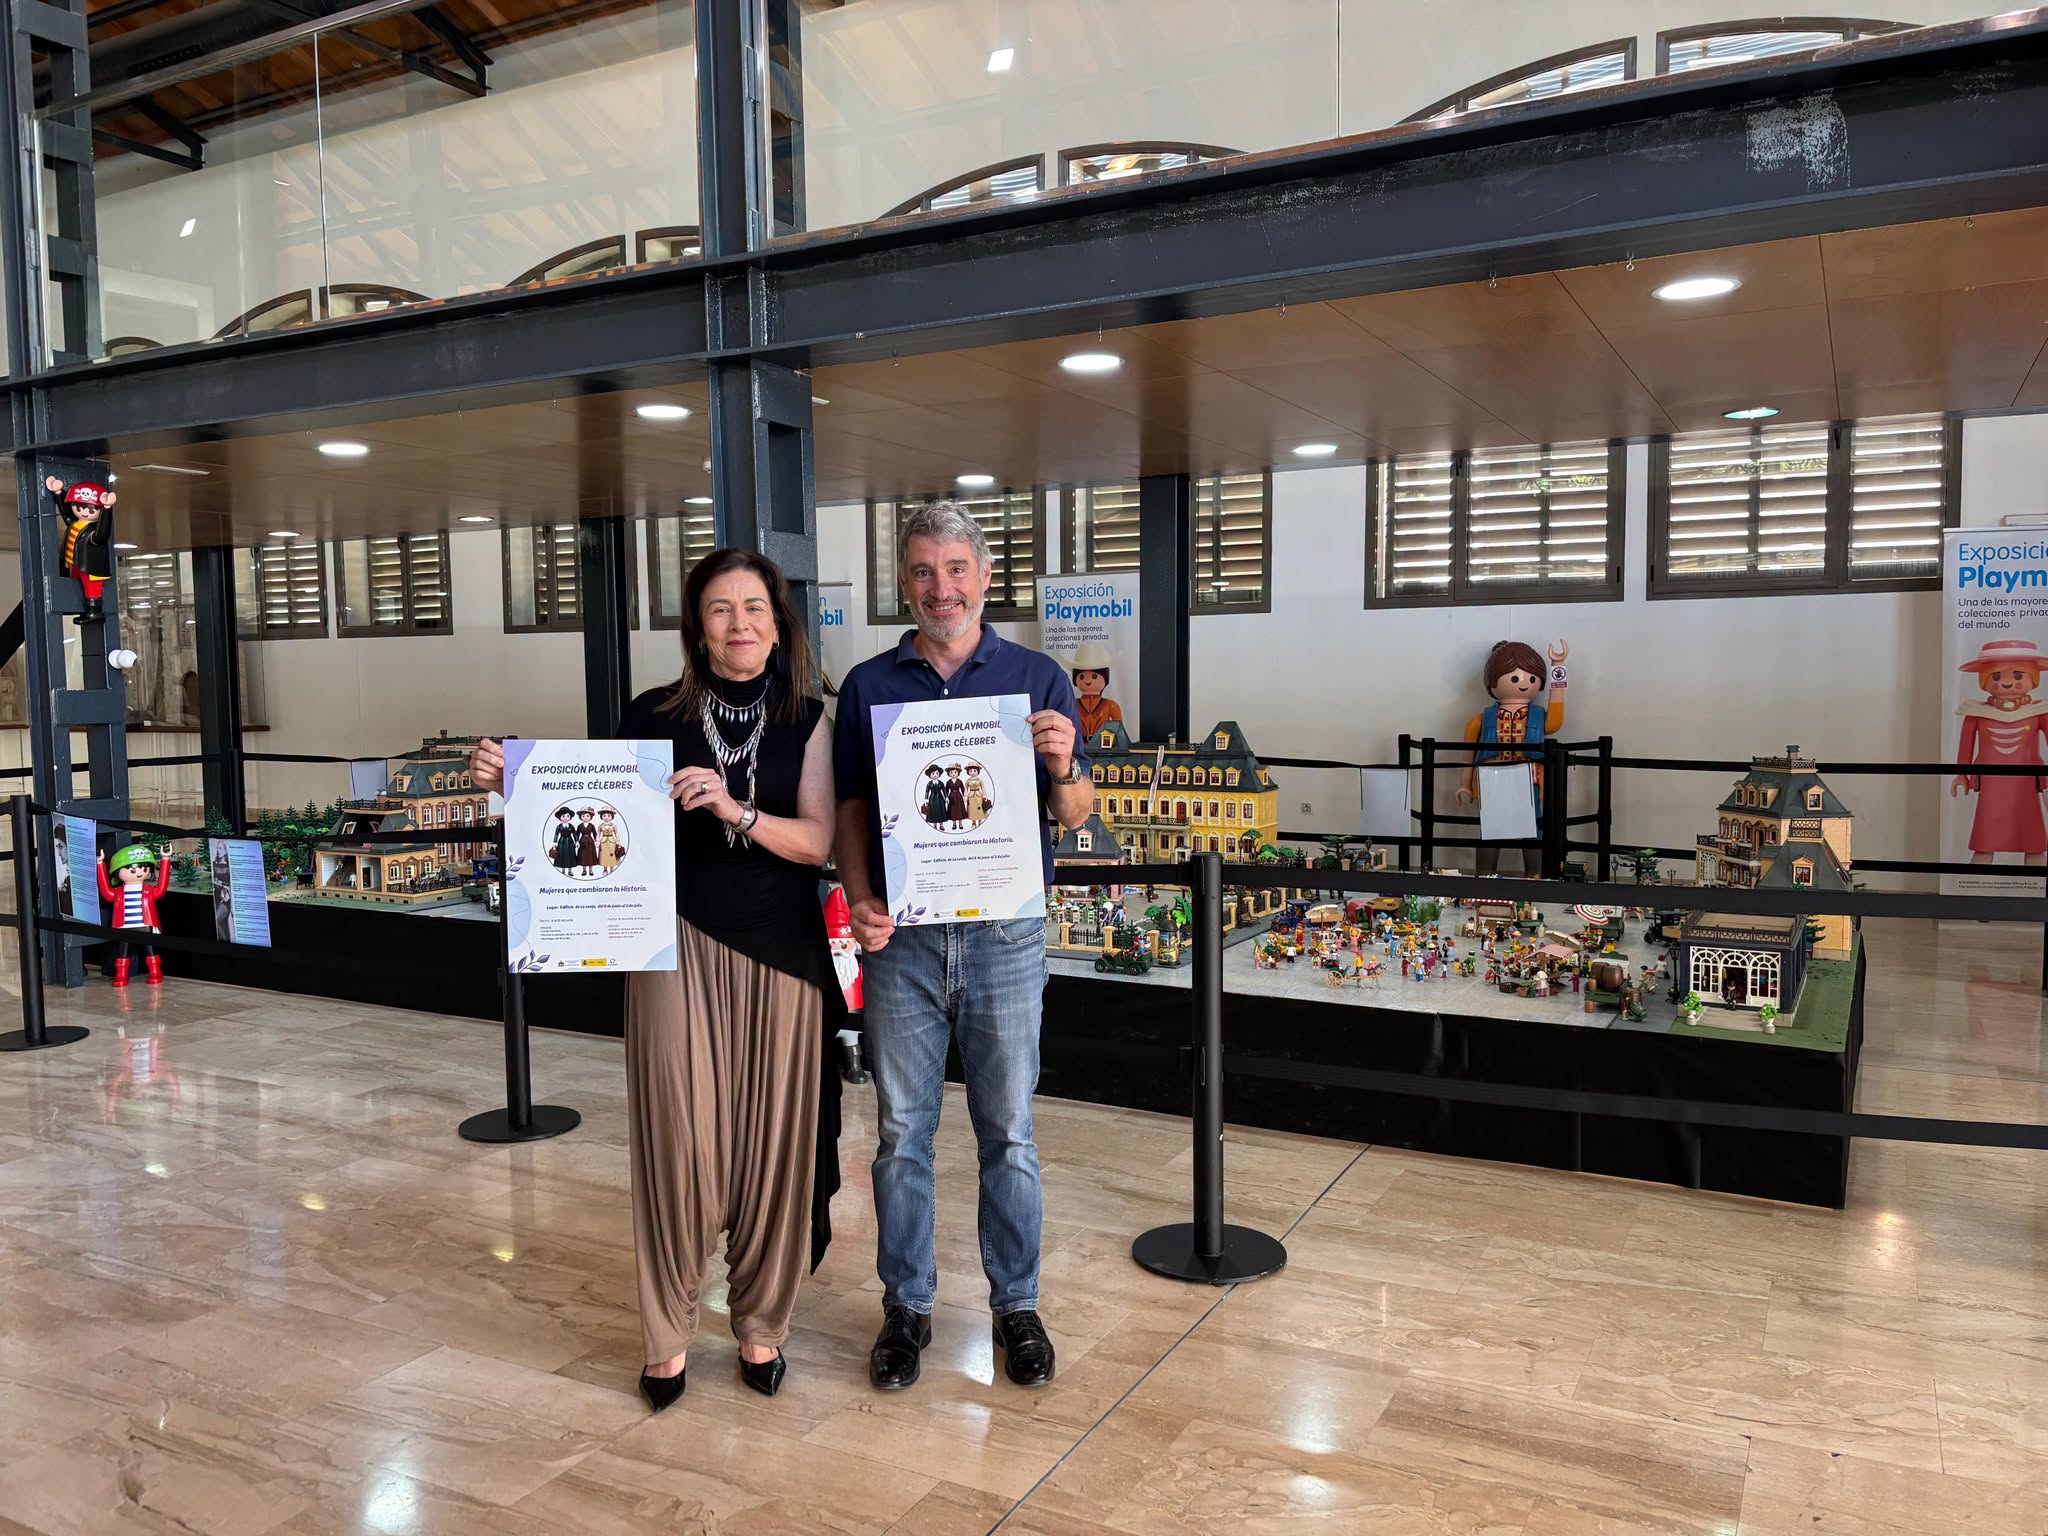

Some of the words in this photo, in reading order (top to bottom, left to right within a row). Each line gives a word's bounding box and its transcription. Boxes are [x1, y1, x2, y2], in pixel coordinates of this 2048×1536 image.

[1959, 541, 2048, 565] Exposici
[1959, 564, 2048, 594] Playm
[1045, 582, 1114, 602] Exposición
[1958, 598, 1978, 606] Una
[1980, 598, 1992, 606] de
[1994, 597, 2008, 606] las
[1045, 598, 1132, 623] Playmobil
[1958, 609, 2015, 618] colecciones
[1958, 620, 1973, 628] del
[1976, 620, 2010, 628] mundo
[1082, 633, 1109, 642] privadas
[901, 722, 953, 736] EXPOSICIÓN
[954, 720, 1002, 731] PLAYMOBIL
[912, 739, 951, 750] MUJERES
[954, 736, 996, 747] CÉLEBRES
[531, 764, 587, 774] EXPOSICIÓN
[588, 765, 639, 774] PLAYMOBIL
[542, 782, 584, 790] MUJERES
[588, 779, 633, 790] CÉLEBRES
[540, 887, 564, 895] Mujeres
